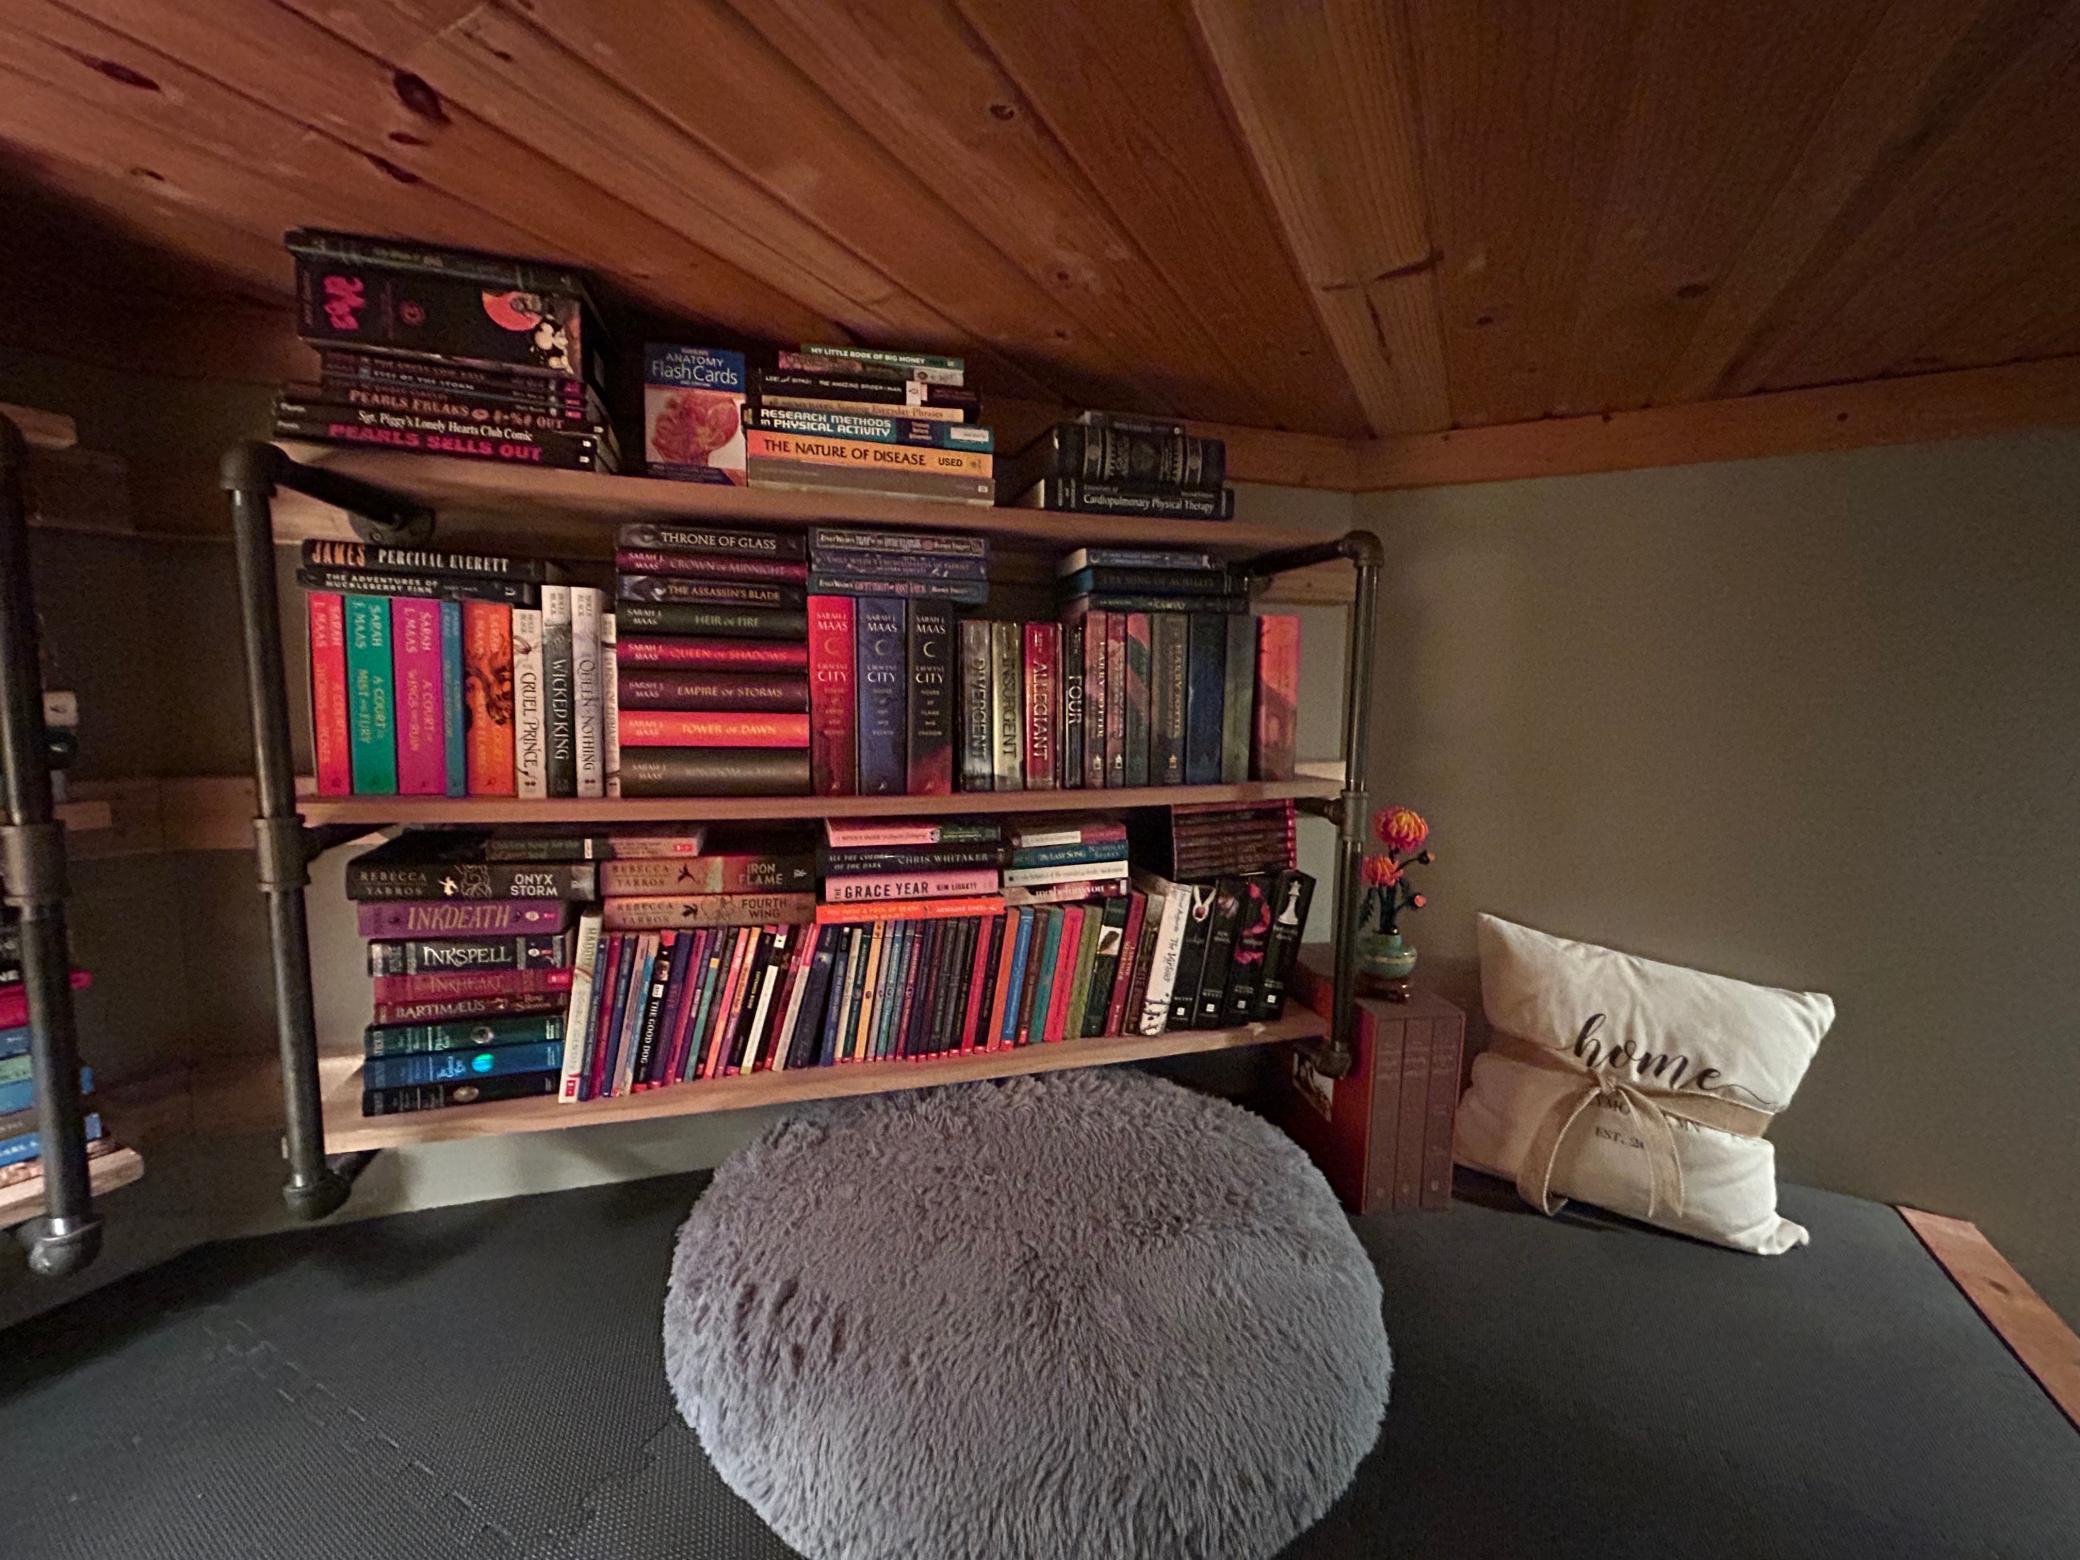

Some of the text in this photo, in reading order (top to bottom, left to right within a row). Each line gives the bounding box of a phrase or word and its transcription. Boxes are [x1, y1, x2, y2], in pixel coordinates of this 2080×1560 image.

[665, 353, 724, 367] ANATOMY
[824, 348, 848, 357] LITTLE
[850, 350, 871, 359] BOOK
[884, 354, 898, 362] BIG
[899, 355, 926, 365] MONEY
[350, 389, 409, 410] PEARLS
[412, 399, 470, 417] FREAKS
[536, 416, 565, 430] OUT
[760, 408, 891, 428] RESEARCH METHODS
[379, 412, 413, 429] Piggy's
[414, 417, 445, 433] Lonely
[448, 421, 479, 435] Hearts
[480, 425, 503, 439] Club
[504, 428, 534, 442] Comic
[760, 418, 891, 438] in PHYSICAL ACTIVITY
[328, 423, 543, 461] PEARLS SELLS OUT
[764, 438, 964, 467] THE NATURE OF DISEASE USED
[1084, 494, 1215, 513] Cardiopulmonary Physical Therapy
[661, 531, 777, 550] THRONE OF GLASS
[311, 543, 509, 573] JAMES PERCIVAL EVERETT
[635, 562, 659, 570] MAAS
[670, 561, 715, 572] CROWN
[325, 580, 404, 592] HUCKLEBERRY
[326, 573, 347, 581] THE
[351, 574, 421, 586] ADVENTURES
[668, 584, 781, 601] THE ASSASSIN'S BLADE
[369, 605, 383, 647] SARAH
[633, 617, 658, 625] MAAS
[695, 616, 722, 626] HEIR
[737, 616, 759, 627] FIRE
[817, 621, 848, 631] MAAS
[867, 623, 898, 633] MAAS
[916, 625, 946, 634] MAAS
[355, 614, 366, 649] MAAS
[405, 618, 417, 654] MAAS
[419, 611, 432, 651] SARAH
[635, 653, 659, 661] MAAS
[817, 672, 848, 683] CITY
[867, 672, 896, 683] CITY
[915, 673, 944, 684] CITY
[635, 690, 660, 698] MAAS
[677, 687, 718, 697] EMPIRE
[738, 688, 783, 698] STORMS
[1068, 675, 1083, 725] FOUR
[374, 688, 386, 729] COURT
[423, 691, 434, 732] COURT
[551, 659, 570, 761] WICKED KING
[579, 660, 596, 771] QUEEN NOTHING
[972, 657, 988, 761] DIVERGENT
[1002, 656, 1018, 759] INSURGENT
[1033, 660, 1048, 761] ALLEGIANT
[519, 672, 541, 768] CRUEL PRINCE
[740, 725, 777, 735] DAWN
[897, 853, 989, 865] CHRIS WHITAKER
[359, 871, 428, 883] REBECCA
[612, 864, 669, 874] REBECCA
[747, 864, 776, 874] IRON
[514, 874, 553, 885] ONYX
[617, 879, 665, 887] YARROS
[738, 873, 783, 885] FLAME
[366, 888, 423, 896] YARROS
[510, 885, 558, 897] STORM
[844, 884, 891, 899] GRACE
[896, 881, 929, 895] YEAR
[742, 898, 787, 909] FOURTH
[407, 905, 511, 930] INKDEATH
[748, 909, 782, 919] WING
[423, 946, 512, 967] INKSPELL
[396, 1001, 486, 1019] BARTIMÆUS
[646, 1018, 657, 1040] GOOD
[640, 1041, 651, 1065] DOG
[1563, 1013, 1770, 1105] home
[1595, 1127, 1625, 1144] EST.
